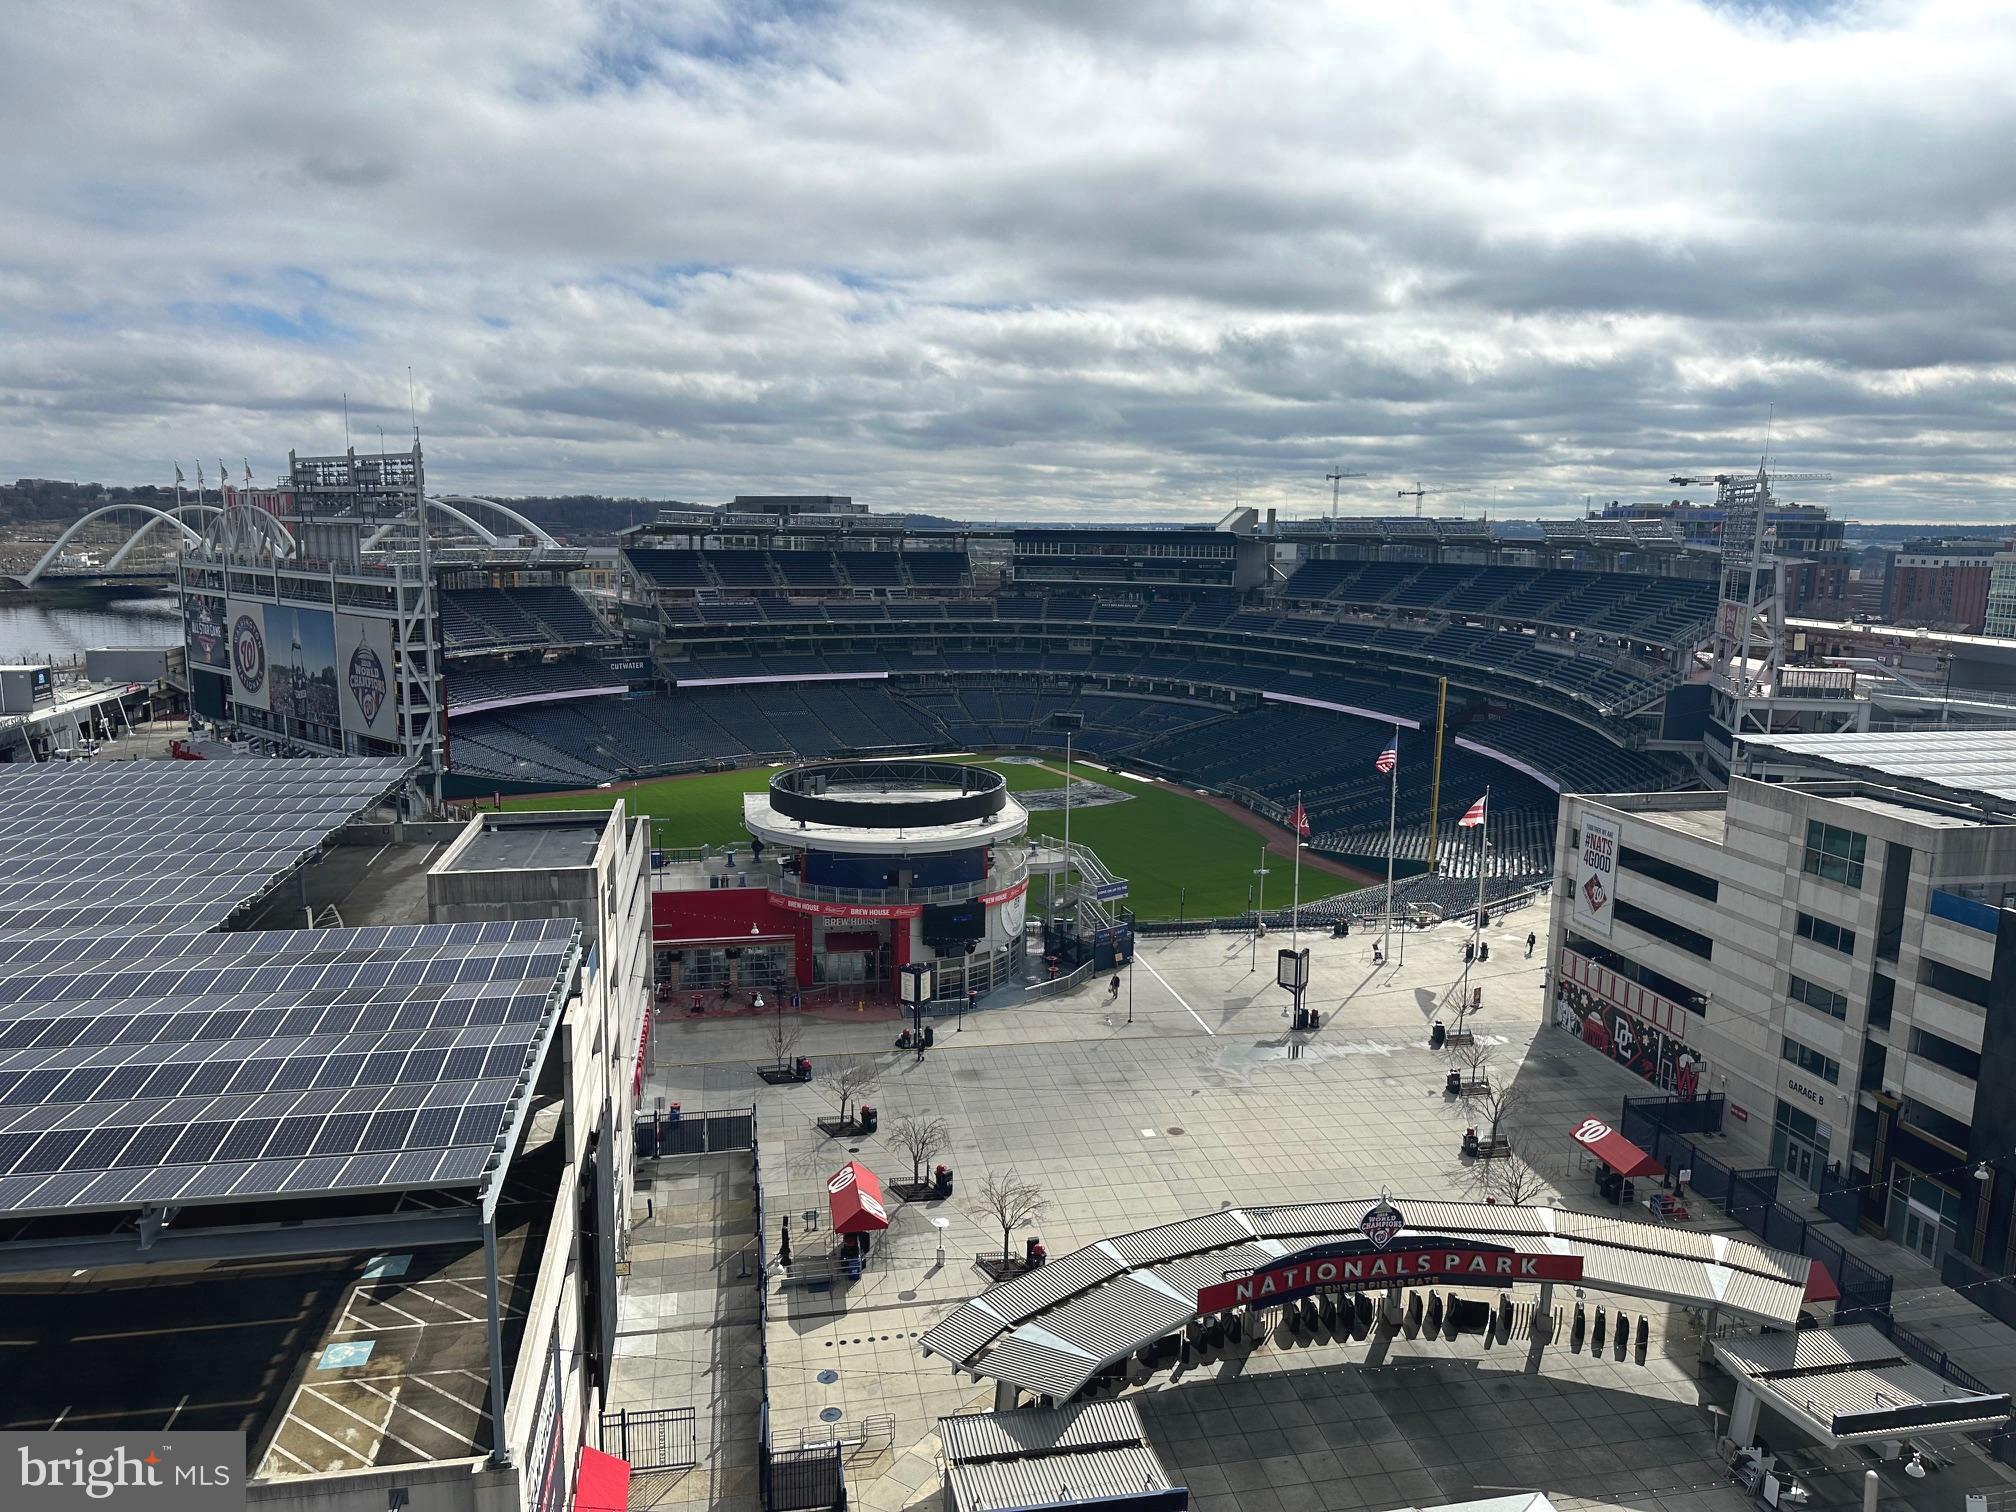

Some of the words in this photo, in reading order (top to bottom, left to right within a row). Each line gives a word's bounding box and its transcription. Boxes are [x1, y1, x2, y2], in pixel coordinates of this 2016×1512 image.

[354, 663, 379, 678] WORLD
[610, 662, 644, 670] CUTWATER
[350, 674, 385, 694] CHAMPIONS
[1585, 833, 1613, 856] #NATS
[1583, 850, 1611, 873] 4GOOD
[802, 903, 819, 912] HOUSE
[824, 918, 849, 927] BREW
[850, 917, 880, 926] HOUSE
[1788, 1080, 1816, 1102] GARAGE
[1818, 1095, 1824, 1105] B
[1362, 1220, 1402, 1230] CHAMPIONS
[1369, 1215, 1396, 1223] WORLD
[1236, 1254, 1432, 1301] NATIONALS
[1445, 1252, 1539, 1276] PARK
[1315, 1282, 1365, 1294] CENTER
[1368, 1280, 1405, 1289] FIELD
[1408, 1276, 1440, 1286] GATE
